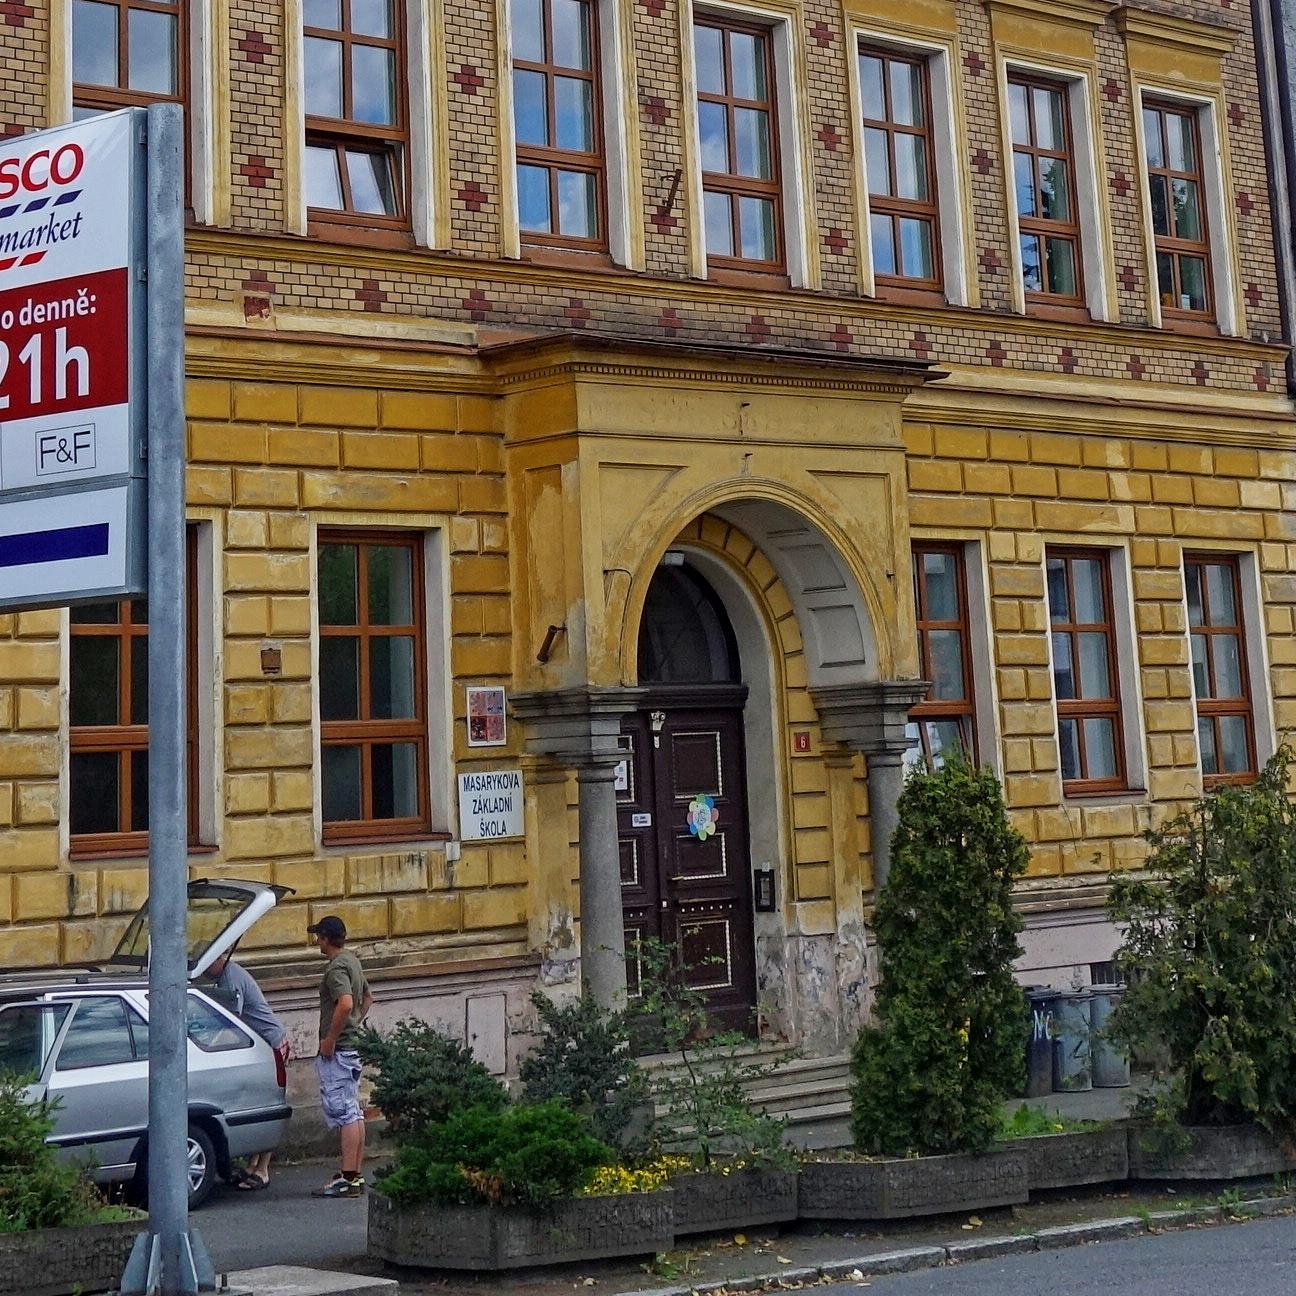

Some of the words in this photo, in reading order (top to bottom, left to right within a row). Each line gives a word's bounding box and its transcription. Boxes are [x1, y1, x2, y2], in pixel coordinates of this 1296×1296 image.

[19, 288, 97, 333] denně:
[40, 430, 91, 471] F&F
[800, 735, 806, 749] 6
[463, 773, 520, 792] MASARYKOVA
[472, 792, 513, 815] ZÁKLADNÍ
[479, 819, 507, 837] ŠKOLA
